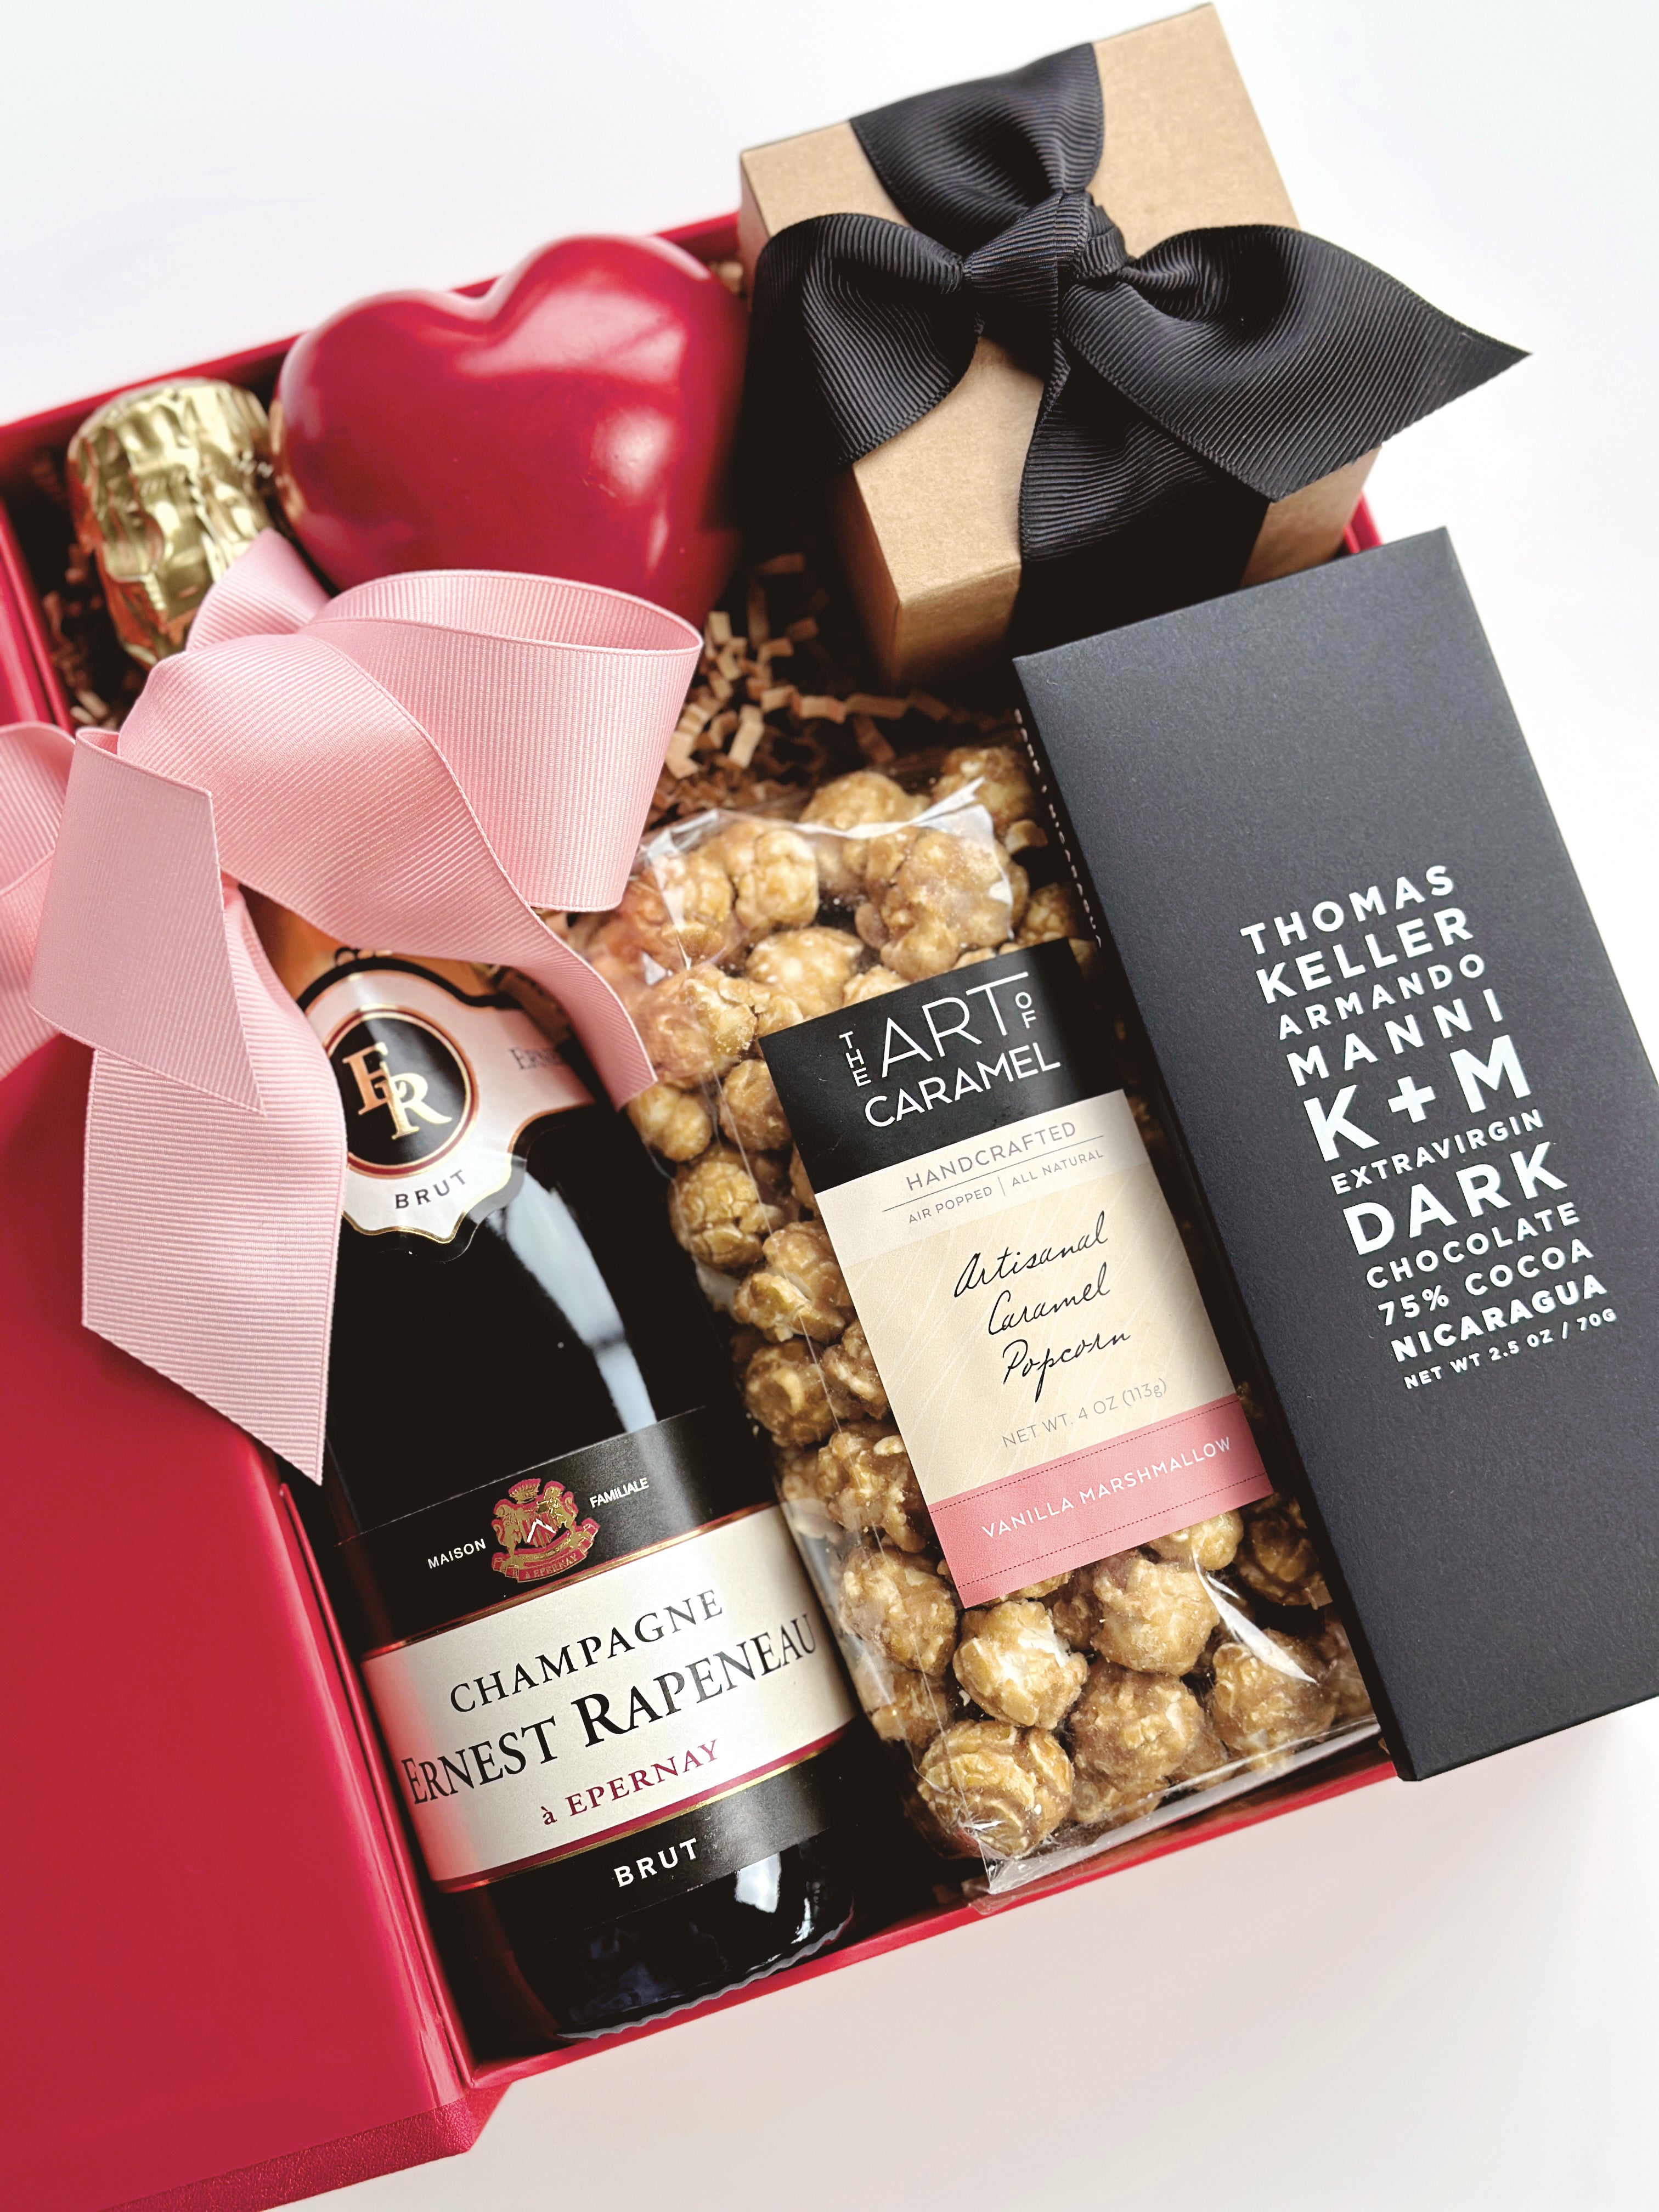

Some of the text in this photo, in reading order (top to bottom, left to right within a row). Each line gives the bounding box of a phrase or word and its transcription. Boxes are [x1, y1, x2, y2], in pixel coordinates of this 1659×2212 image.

[1240, 865, 1454, 955] THOMAS
[1256, 907, 1474, 1004] KELLER
[1279, 953, 1485, 1040] ARMANDO
[839, 972, 1037, 1087] THE ART OF
[1286, 988, 1503, 1087] MANNI
[864, 1042, 1061, 1127] CARAMEL
[394, 1169, 467, 1209] BRUT
[906, 1121, 1076, 1192] HANDCRAFTED
[908, 1149, 1104, 1224] AIR POPPED ALL NATURAL
[1330, 1109, 1545, 1195] EXTRAVIRGIN
[1342, 1141, 1568, 1256] DARK
[953, 1210, 1108, 1298] Artisanal
[1366, 1201, 1581, 1289] CHOCOLATE
[1378, 1238, 1594, 1326] 75% COCOA
[988, 1261, 1111, 1335] Caramel
[1391, 1274, 1607, 1363] NICARAGUA
[1002, 1333, 1131, 1403] Popcorn
[1404, 1308, 1617, 1390] NET WT 2.5 OZ / 70G
[1001, 1378, 1167, 1448] NET WT. 4 OZ (113g)
[427, 1477, 650, 1570] MAISON FAMILIALE
[981, 1436, 1231, 1538] VANILLA MARSHMALLOW
[449, 1588, 724, 1713] CHAMPAGNE
[401, 1613, 817, 1805] ERNEST RAPENEAU
[566, 1738, 719, 1816] EPERNAY
[613, 1837, 699, 1888] BRUT
